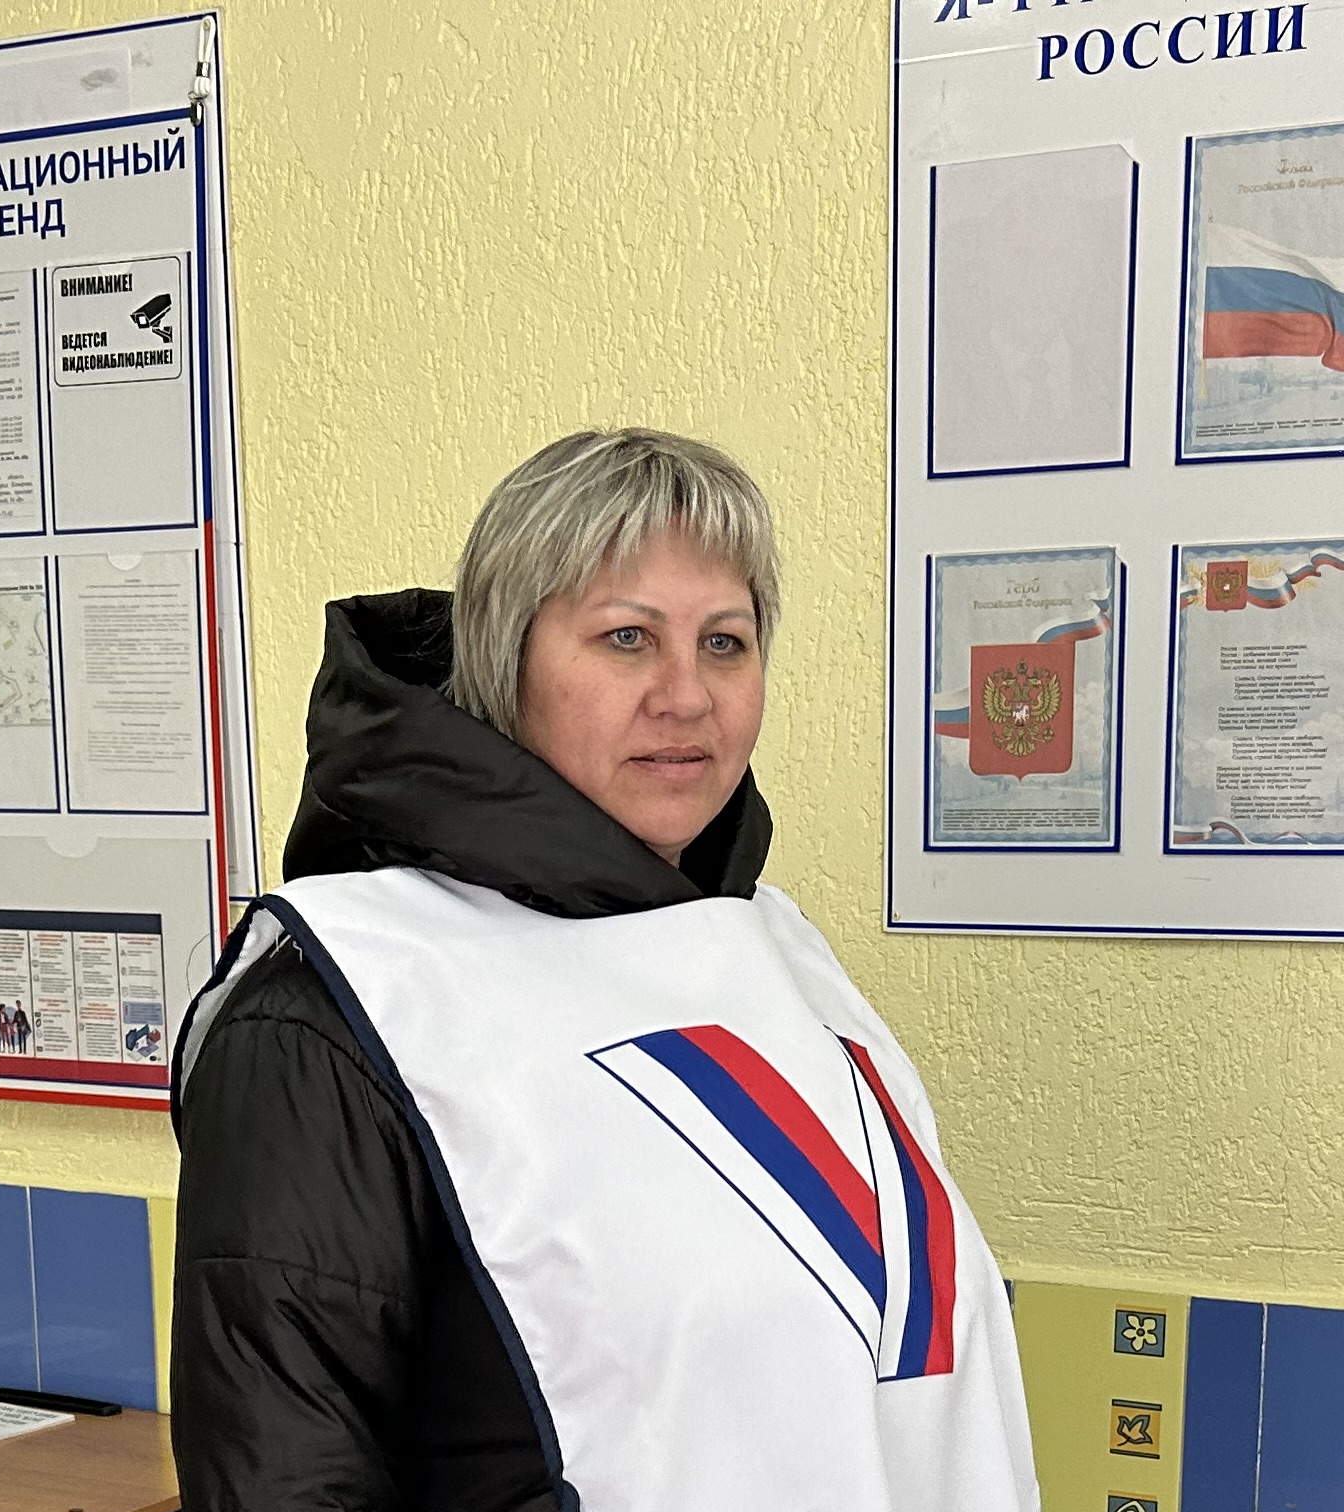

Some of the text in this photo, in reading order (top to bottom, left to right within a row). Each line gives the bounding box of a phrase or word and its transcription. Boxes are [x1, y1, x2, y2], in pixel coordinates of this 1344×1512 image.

[1036, 3, 1309, 81] РОССИИ
[60, 274, 133, 298] ВНИМАНИЕ!
[61, 332, 107, 351] ВЕДЕТСЯ
[62, 348, 174, 373] ВИДЕОНАБЛЮДЕНИЕ!
